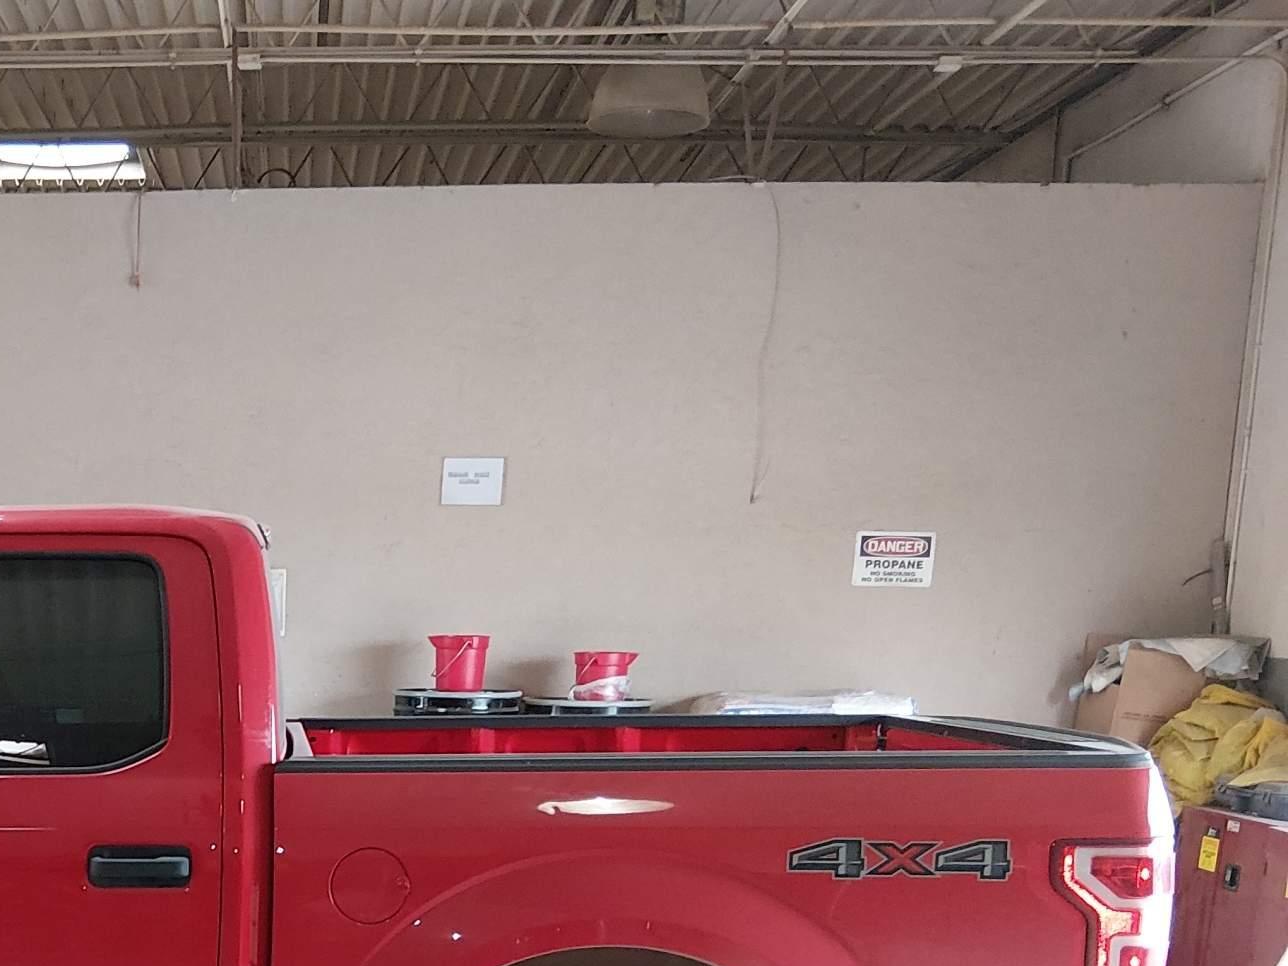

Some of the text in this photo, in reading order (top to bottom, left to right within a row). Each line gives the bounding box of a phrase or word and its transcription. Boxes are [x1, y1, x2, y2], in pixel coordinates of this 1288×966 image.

[867, 540, 924, 553] DANGER
[865, 559, 924, 569] PROPANE
[786, 837, 1012, 881] 4X4
